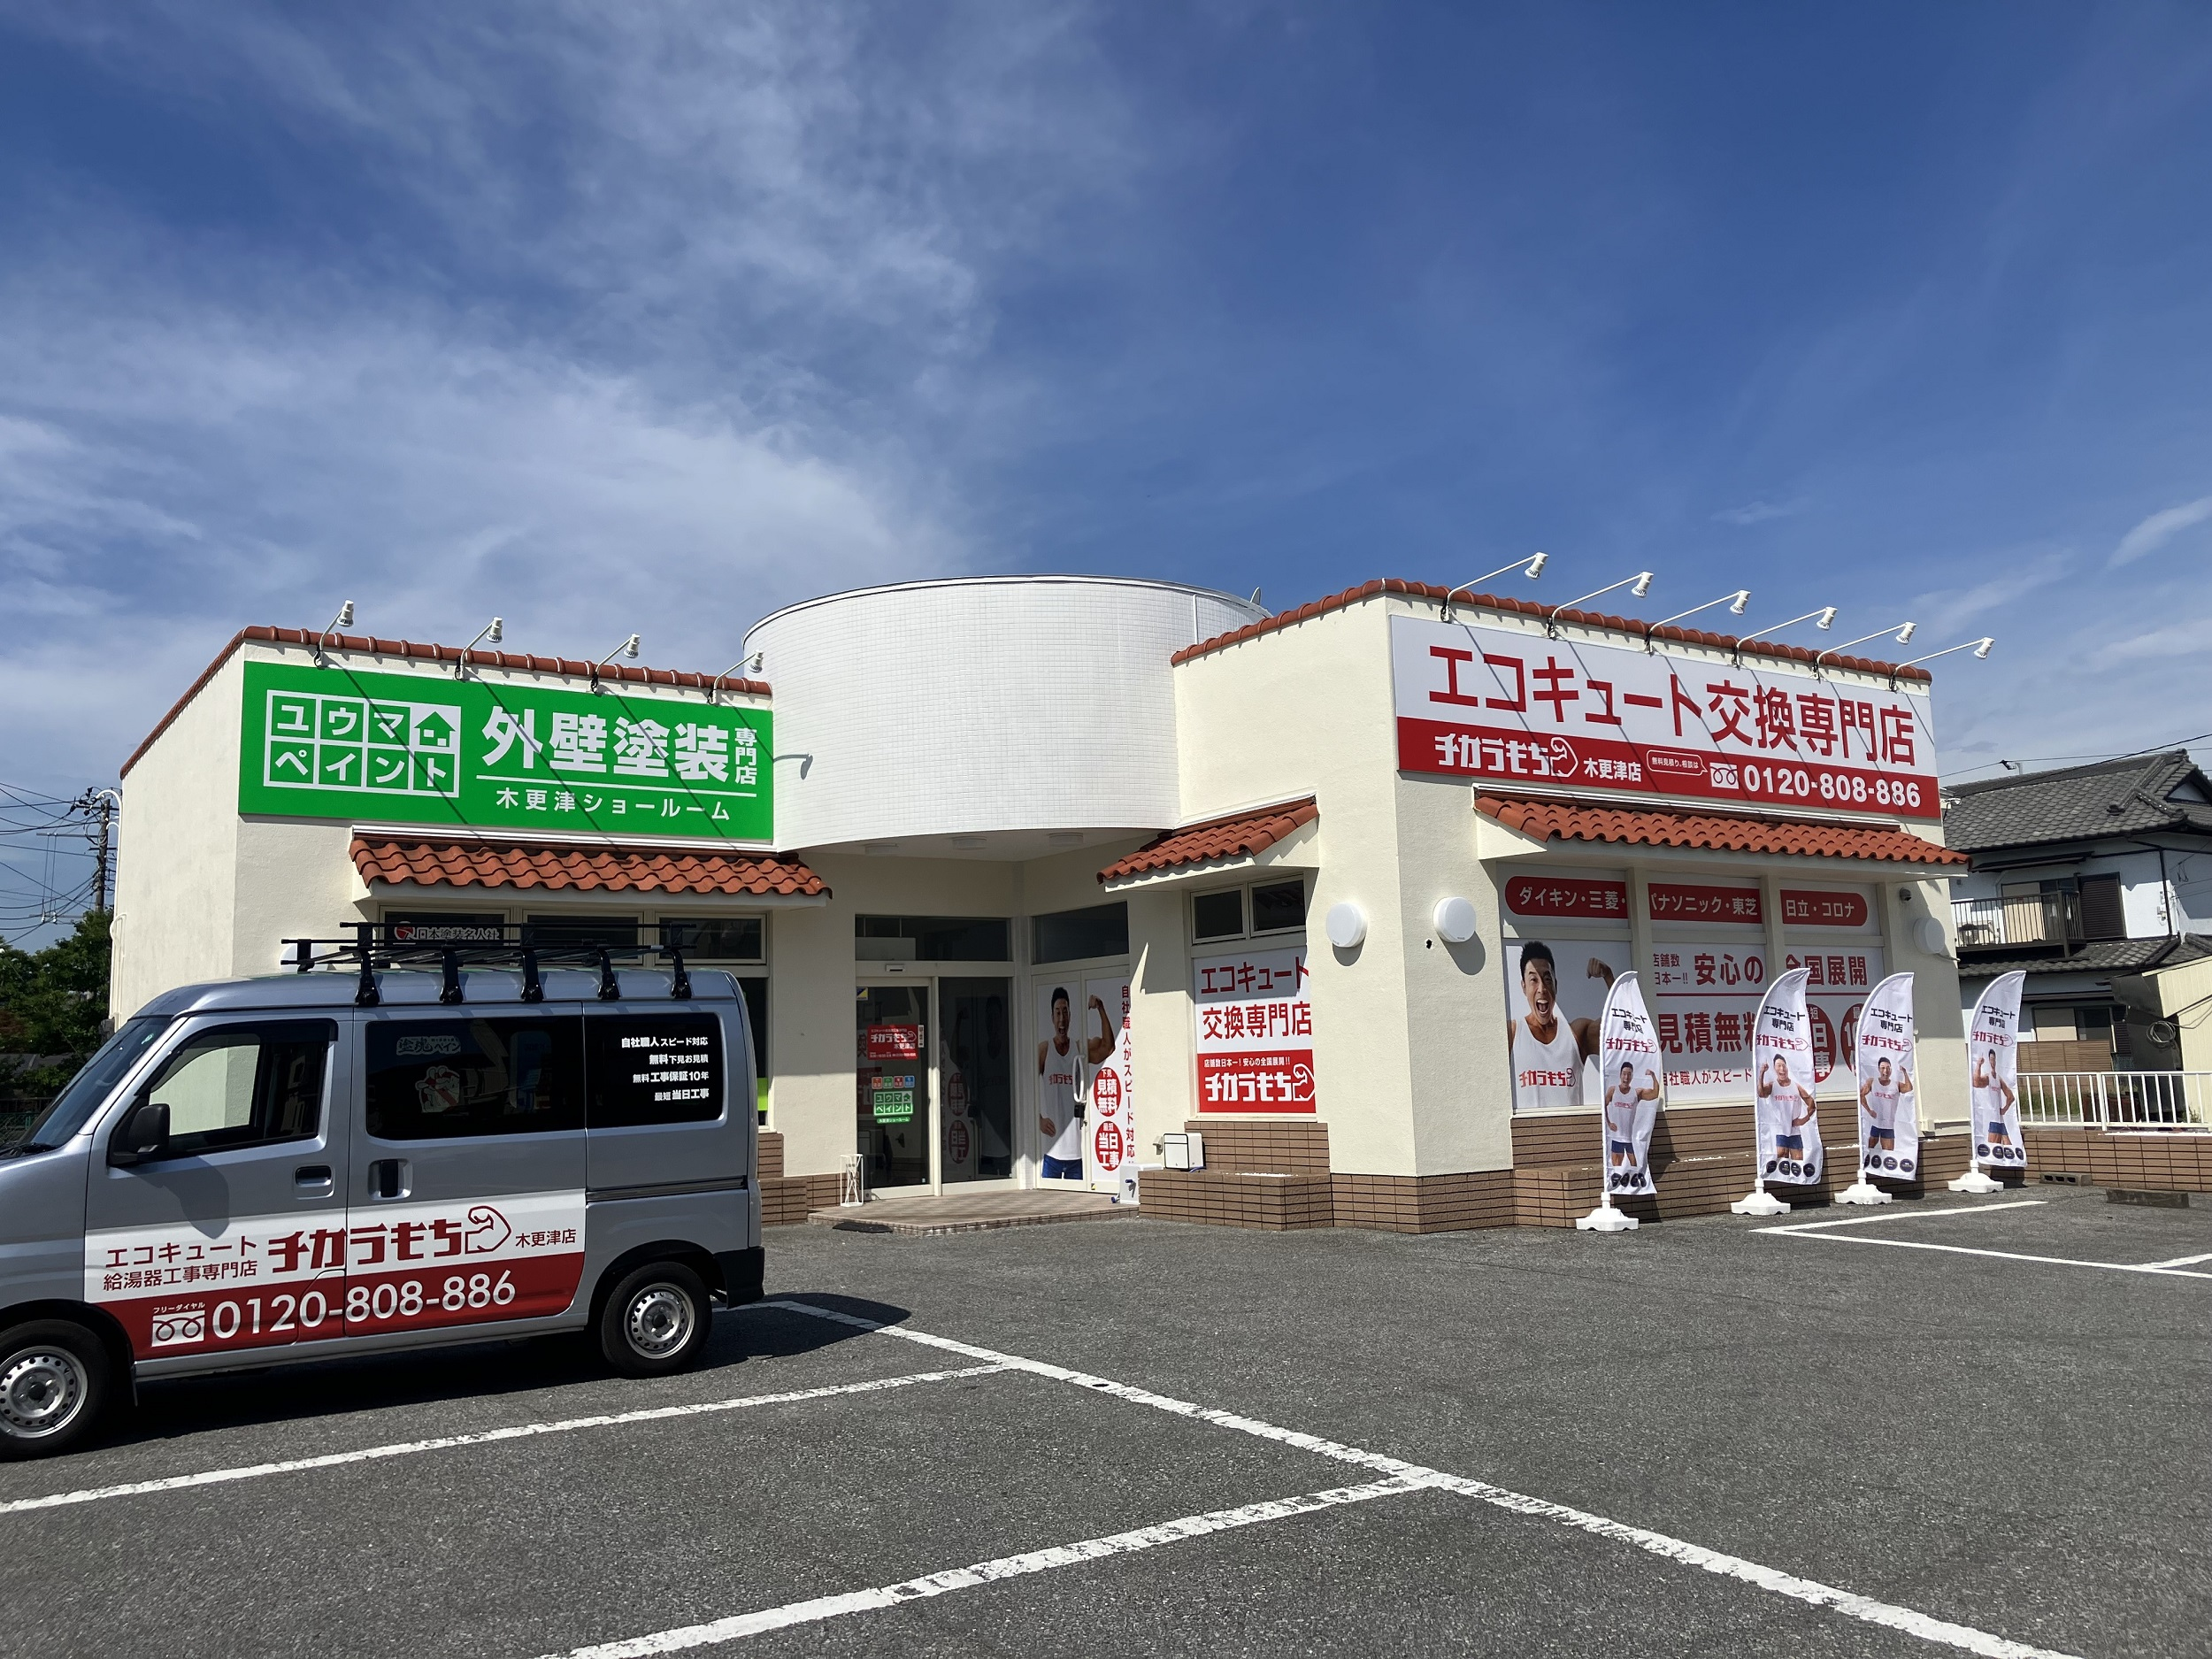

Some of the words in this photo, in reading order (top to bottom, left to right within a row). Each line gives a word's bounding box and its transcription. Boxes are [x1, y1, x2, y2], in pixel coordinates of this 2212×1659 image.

[1430, 646, 1916, 767] エコキュート交換専門店
[276, 704, 403, 740] ユウマ
[481, 705, 730, 782] 外壁塗装
[734, 727, 758, 785] 専門店
[1434, 733, 1554, 777] チカラもち
[274, 749, 447, 787] ペイント
[1583, 757, 1642, 783] 木更津店
[1743, 768, 1921, 808] 0120-808-886
[495, 787, 732, 821] 木更津ショールーム
[1786, 899, 1855, 918] 日立・コロナ
[1653, 953, 1681, 968] 店舗数
[1694, 953, 1764, 986] 安心の
[1201, 956, 1309, 994] エコキュート
[1202, 1001, 1312, 1041] 交換専門店
[1763, 1005, 1806, 1021] エコキュート
[1870, 1007, 1913, 1023] エコキュート
[1981, 1004, 2016, 1019] エコキュート
[1771, 1018, 1794, 1033] 専門店
[1812, 1023, 1828, 1048] 日
[1880, 1019, 1903, 1033] 専門店
[621, 1036, 709, 1048] 自社職人スピード対応
[1862, 1034, 1904, 1052] チカラもち
[649, 1054, 709, 1065] 無料下見お見積
[1814, 1050, 1832, 1077] 事
[633, 1071, 710, 1083] 無料工事保証10年
[1101, 1069, 1112, 1078] 下見
[1121, 985, 1135, 1164] 自社職人がスピード対応
[1519, 1069, 1568, 1088] チカラもち
[654, 1087, 710, 1102] 最短当日工事
[1097, 1079, 1118, 1096] 見積
[1204, 1071, 1294, 1102] チカラもち
[876, 1103, 910, 1113] ペイント
[1097, 1097, 1118, 1114] 無料
[1098, 1132, 1119, 1149] 当日
[1099, 1151, 1120, 1168] 工事
[268, 1219, 465, 1273] チカラもち
[515, 1227, 578, 1249] 木更津店
[105, 1235, 257, 1268] エコキュート
[103, 1259, 258, 1292] 給湯器工事専門店
[152, 1302, 206, 1315] フリーダイヤル
[211, 1270, 517, 1340] 0120-808-886
